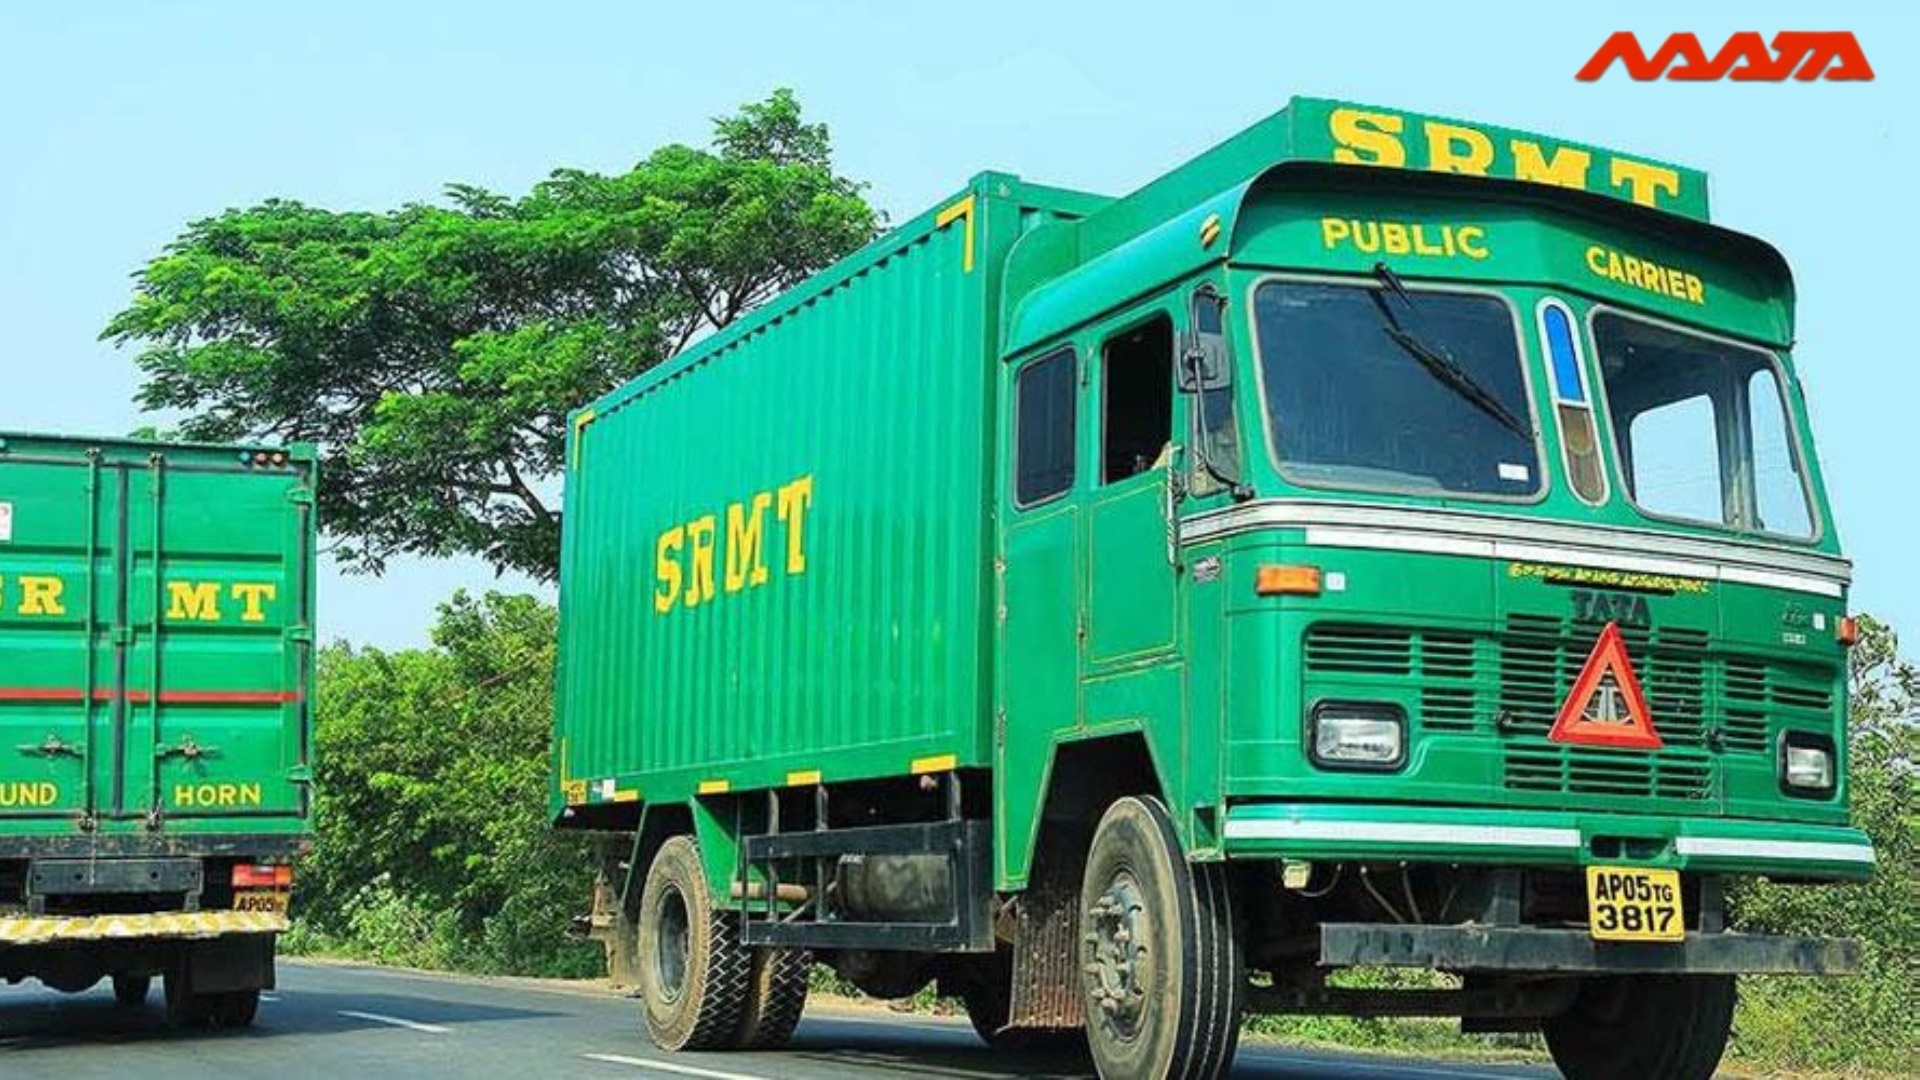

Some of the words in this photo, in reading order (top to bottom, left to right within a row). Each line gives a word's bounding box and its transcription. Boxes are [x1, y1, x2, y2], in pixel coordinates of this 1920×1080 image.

[1329, 108, 1679, 208] SRMT
[1321, 218, 1488, 258] PUBLIC
[1585, 246, 1704, 303] CARRIER
[655, 475, 814, 614] SRMT
[166, 582, 276, 620] MT
[1572, 590, 1651, 625] TATA
[174, 783, 261, 805] HORN
[1597, 904, 1675, 932] 3817
